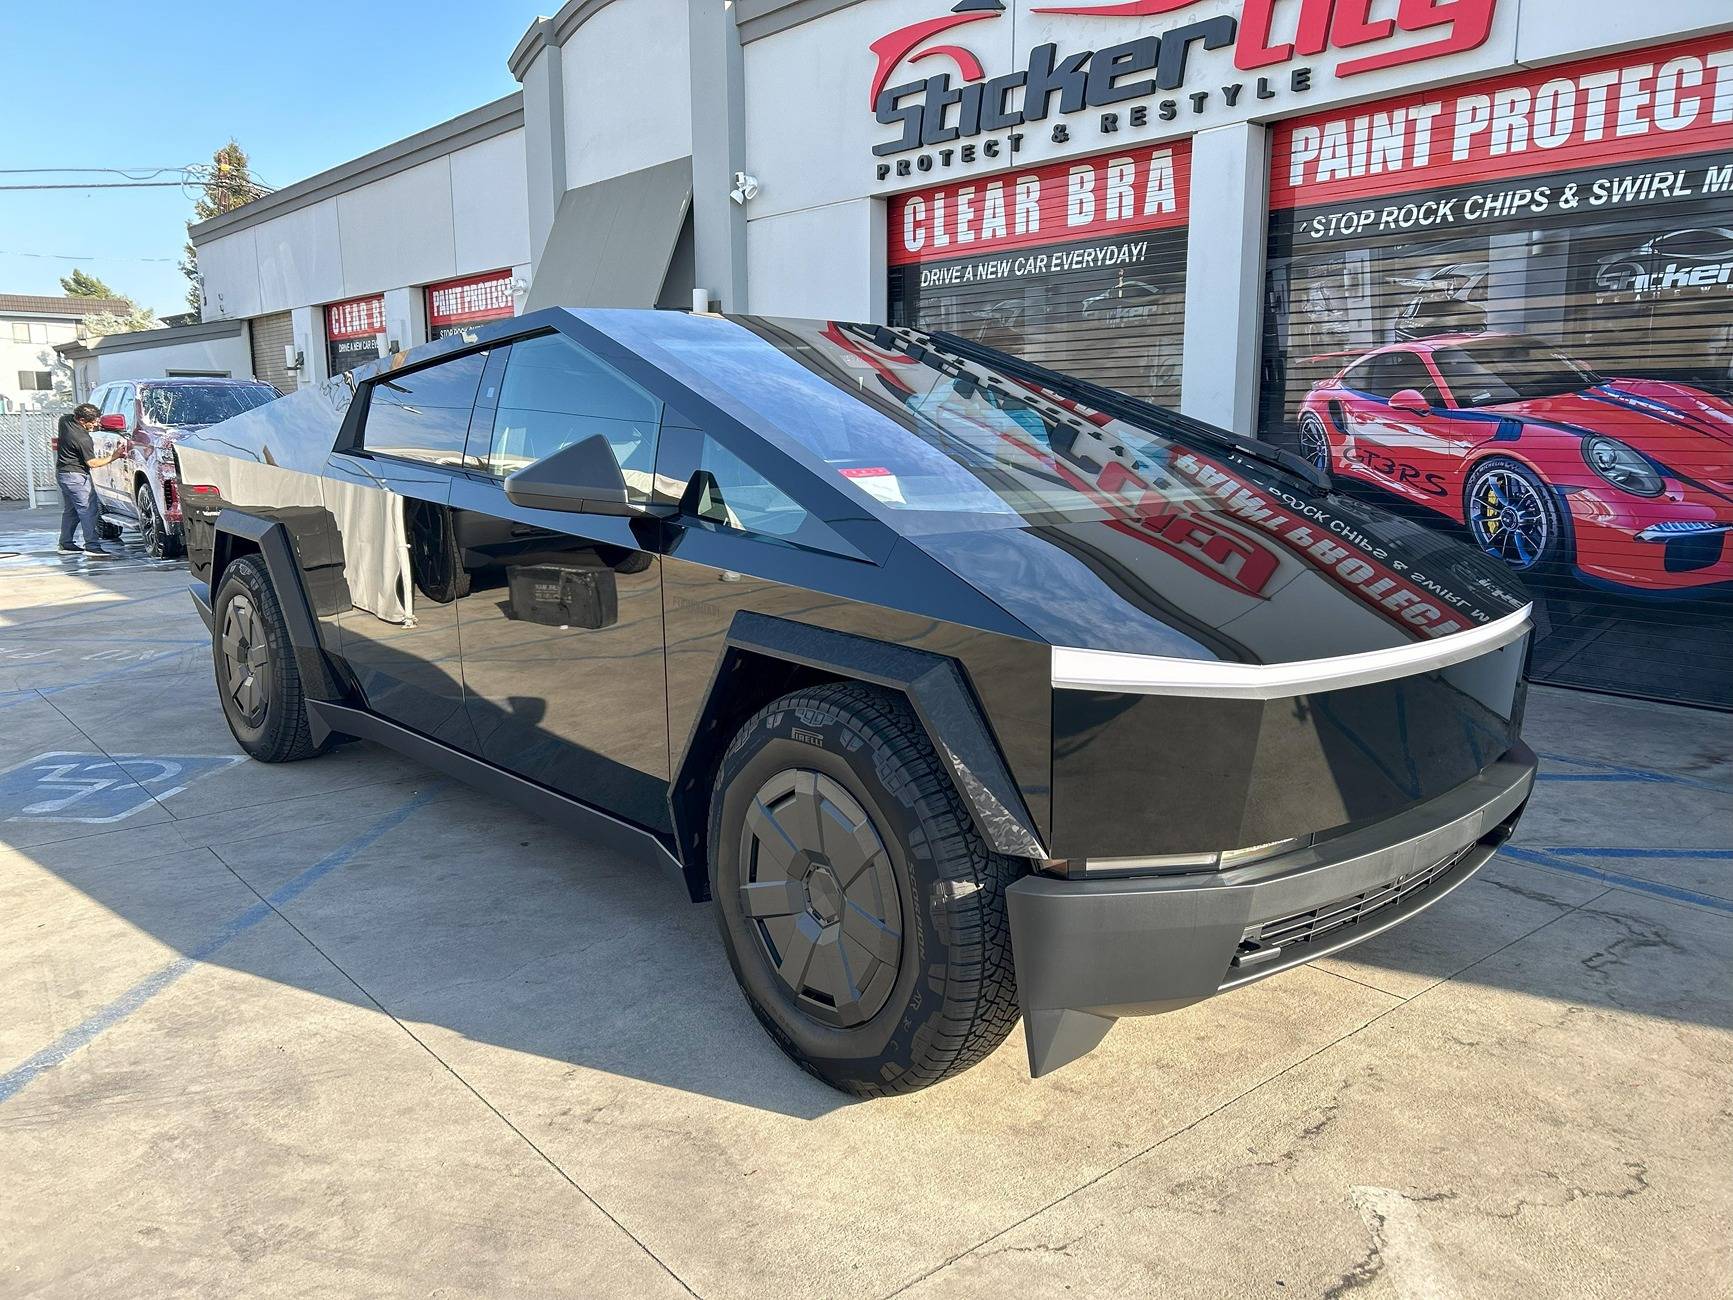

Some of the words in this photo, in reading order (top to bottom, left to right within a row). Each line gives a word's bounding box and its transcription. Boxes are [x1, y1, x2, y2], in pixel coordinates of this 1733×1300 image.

[877, 134, 1023, 180] PROTECT
[1051, 124, 1070, 143] &
[1100, 67, 1312, 133] RESTYLE
[1289, 101, 1441, 186] PAINT
[904, 175, 1040, 252] CLEAR
[1067, 148, 1176, 227] BRA
[1311, 210, 1374, 238] STOP
[1379, 198, 1455, 231] ROCK
[1464, 188, 1551, 221] CHIPS
[1560, 182, 1579, 209] &
[1589, 169, 1691, 206] SWIRL
[1702, 164, 1733, 193] M
[921, 265, 961, 287] DRIVE
[963, 264, 974, 282] A
[976, 259, 1010, 280] NEW
[1014, 255, 1047, 276] CAR
[1050, 242, 1147, 271] EVERYDAY!
[332, 303, 367, 335] CLEAR
[433, 287, 462, 316] PAINT
[792, 727, 824, 747] PIRELLI
